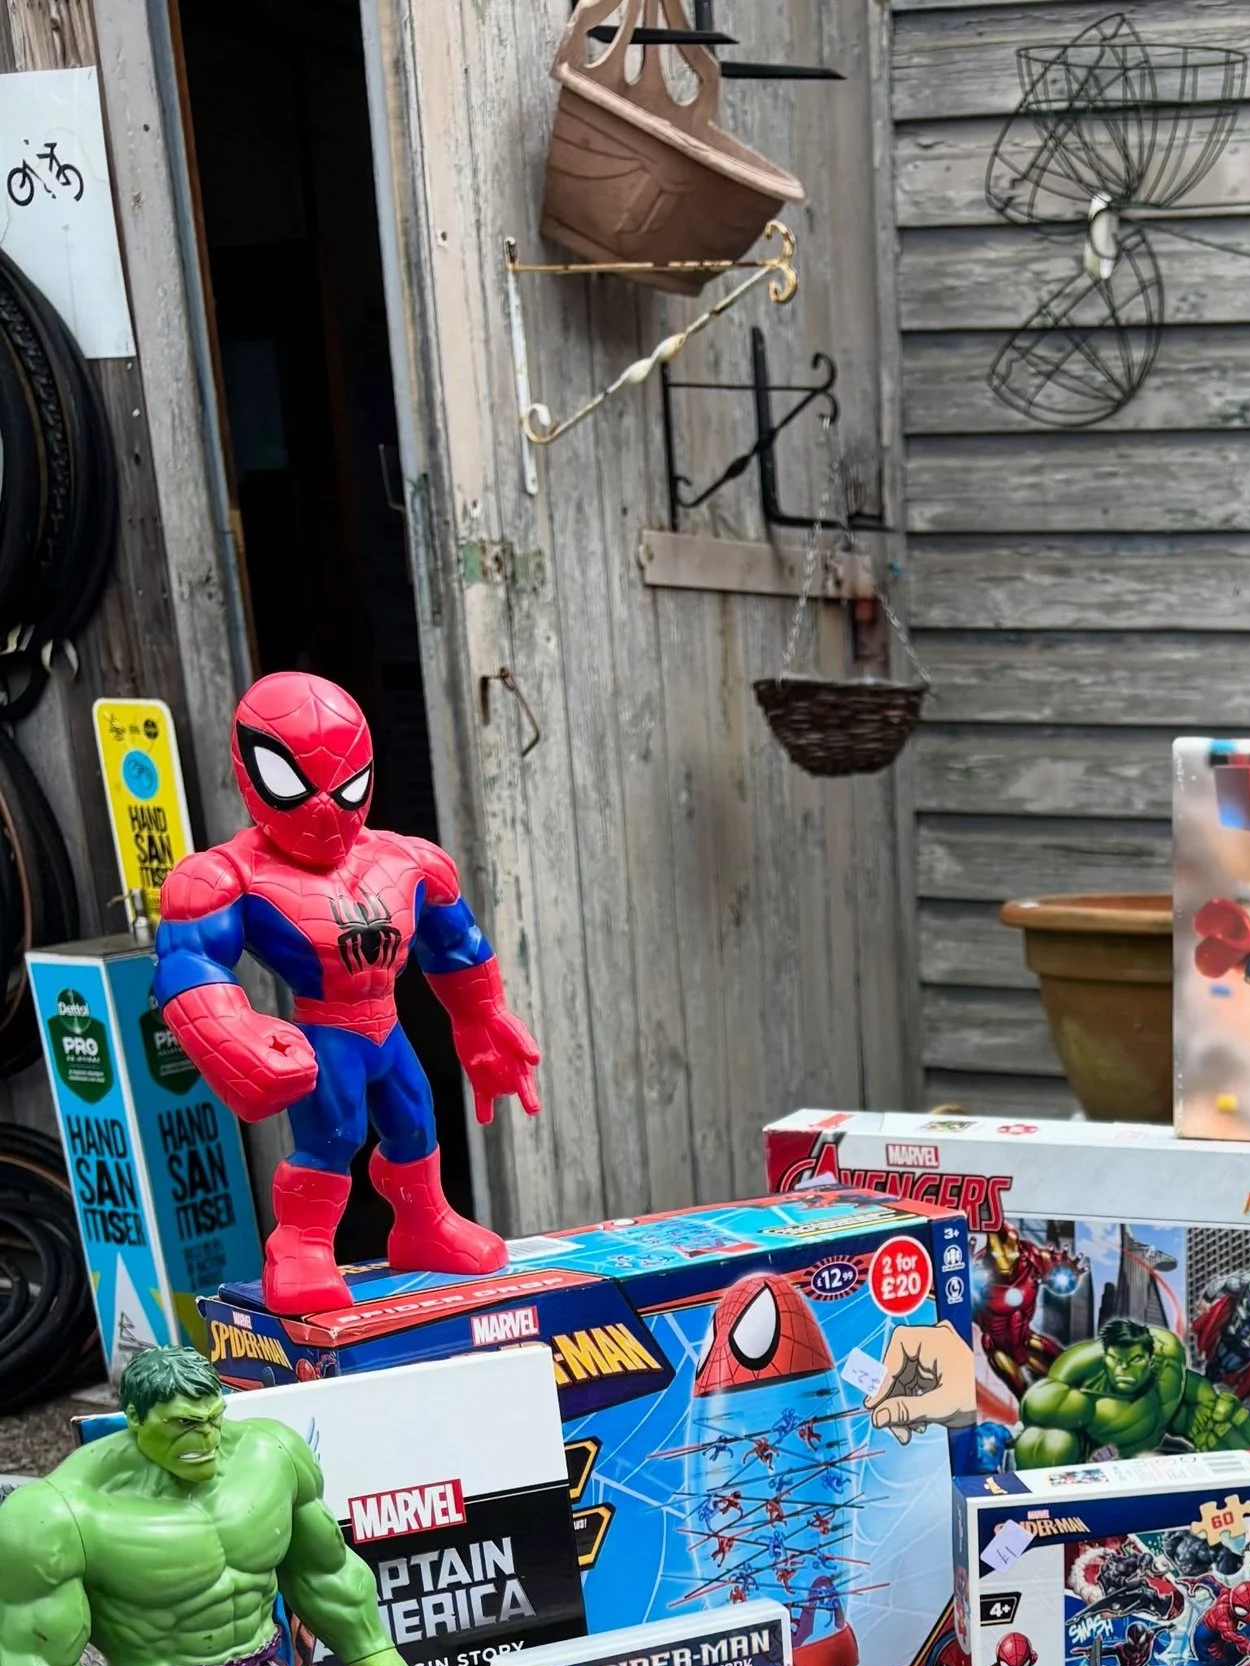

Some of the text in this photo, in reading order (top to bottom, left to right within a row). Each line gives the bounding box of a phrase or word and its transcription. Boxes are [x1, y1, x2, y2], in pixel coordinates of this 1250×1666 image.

[128, 805, 167, 833] HAND
[134, 833, 174, 865] SAN
[57, 1001, 90, 1017] Dettol
[62, 1036, 99, 1056] PRO
[153, 1031, 179, 1049] PR
[66, 1114, 128, 1160] HAND
[157, 1102, 219, 1154] HAND
[889, 1144, 939, 1167] MARVEL
[75, 1157, 139, 1211] SAN
[166, 1147, 229, 1204] SAN
[82, 1209, 148, 1248] ITISER
[174, 1191, 237, 1242] ITISER
[944, 1228, 960, 1239] 3+
[882, 1253, 918, 1275] 2 for
[337, 1276, 565, 1324] SPIDER DROP
[881, 1271, 922, 1301] £20
[472, 1307, 539, 1344] MARVEL
[211, 1320, 294, 1371] SPIDER-MAN
[351, 1483, 464, 1541] MARVEL
[994, 1515, 1092, 1537] DER-MAN
[1210, 1510, 1234, 1529] 60
[376, 1537, 516, 1601] PTAIN
[989, 1602, 1013, 1619] 4+
